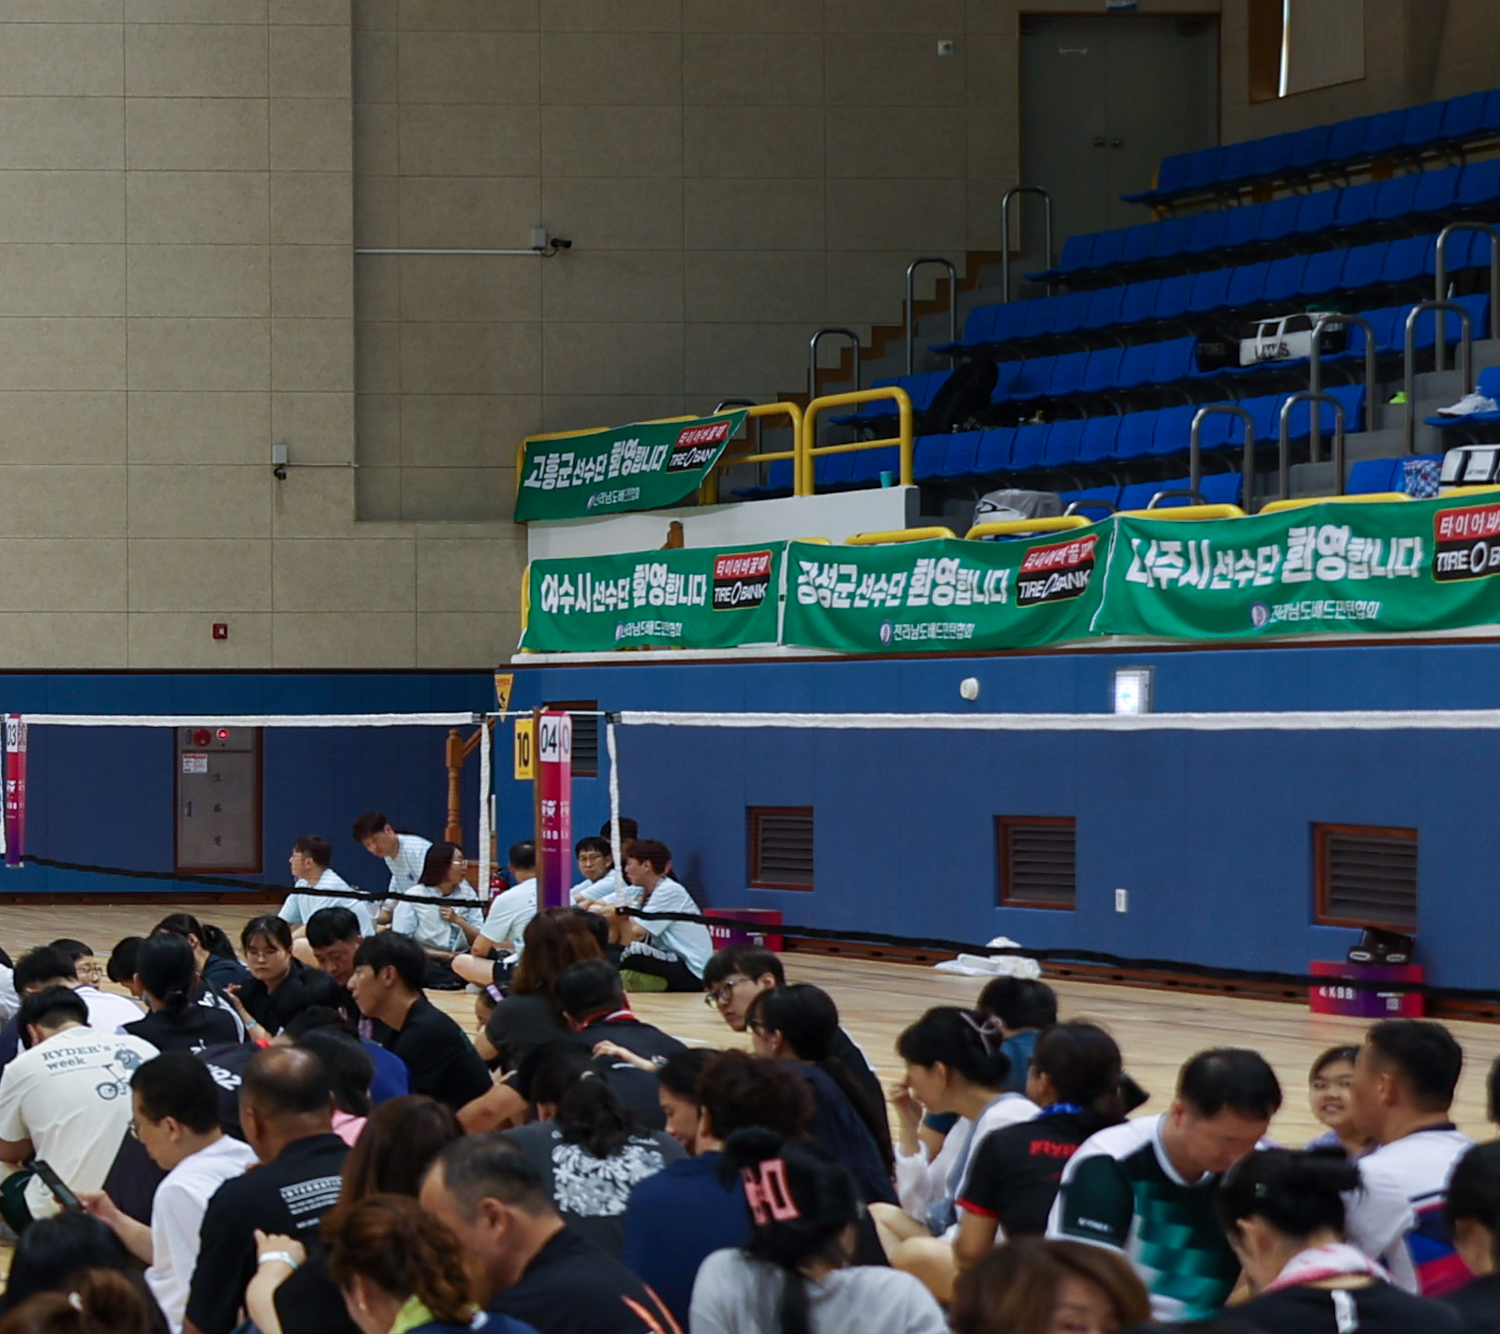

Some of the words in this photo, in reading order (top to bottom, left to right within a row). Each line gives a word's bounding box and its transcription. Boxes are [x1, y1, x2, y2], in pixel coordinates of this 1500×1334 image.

[1210, 543, 1282, 590] 선수단
[1280, 523, 1424, 584] 환영합니다
[540, 571, 592, 615] 여수시
[592, 577, 631, 613] 선수단
[631, 562, 708, 608] 환영합니다
[797, 559, 859, 609] 장성군
[855, 571, 908, 607] 선수단
[906, 556, 1011, 608] 환영합니다
[517, 732, 531, 767] 10
[540, 721, 557, 755] 04
[45, 1055, 86, 1072] week
